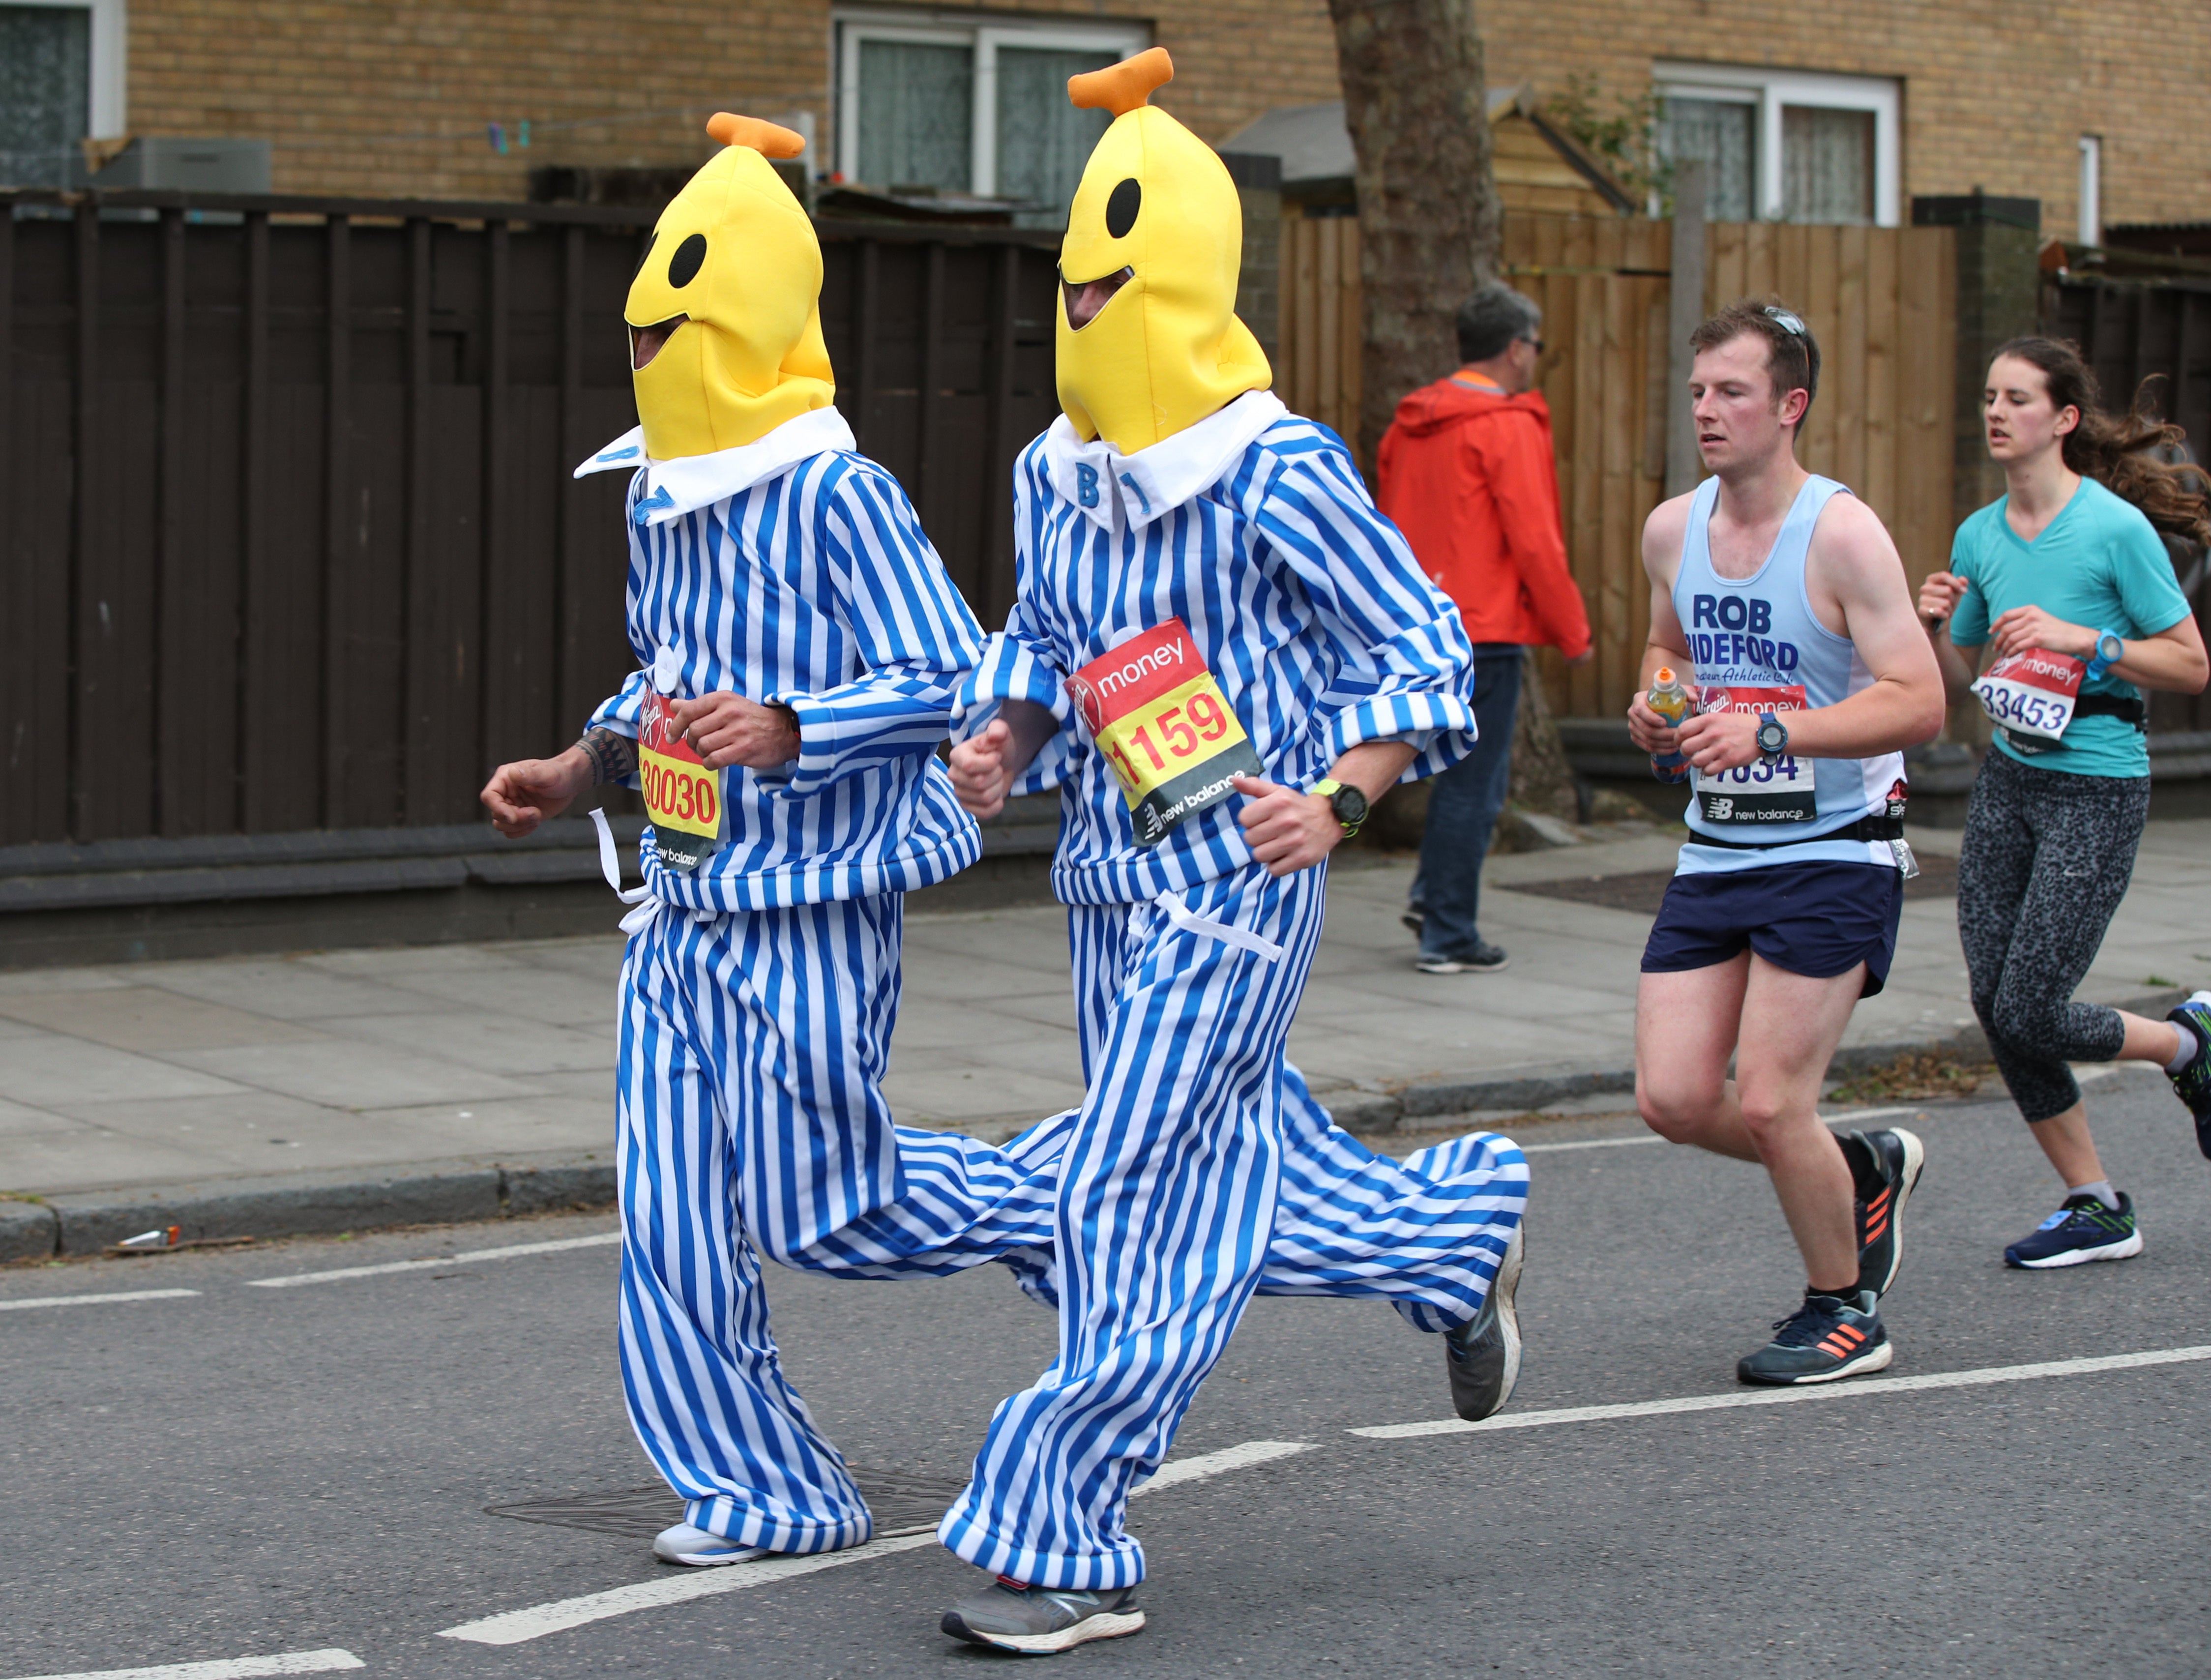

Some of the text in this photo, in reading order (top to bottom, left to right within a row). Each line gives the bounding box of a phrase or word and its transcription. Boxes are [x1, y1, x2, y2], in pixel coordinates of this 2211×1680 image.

[1075, 462, 1099, 508] B
[1693, 594, 1772, 635] ROB
[1097, 637, 1184, 697] money
[1722, 667, 1771, 682] Athletic
[2022, 657, 2077, 686] money
[1979, 684, 2066, 730] 33453
[643, 759, 716, 824] 30030
[1160, 800, 1184, 825] new
[1736, 811, 1756, 820] new
[1757, 809, 1803, 821] balance
